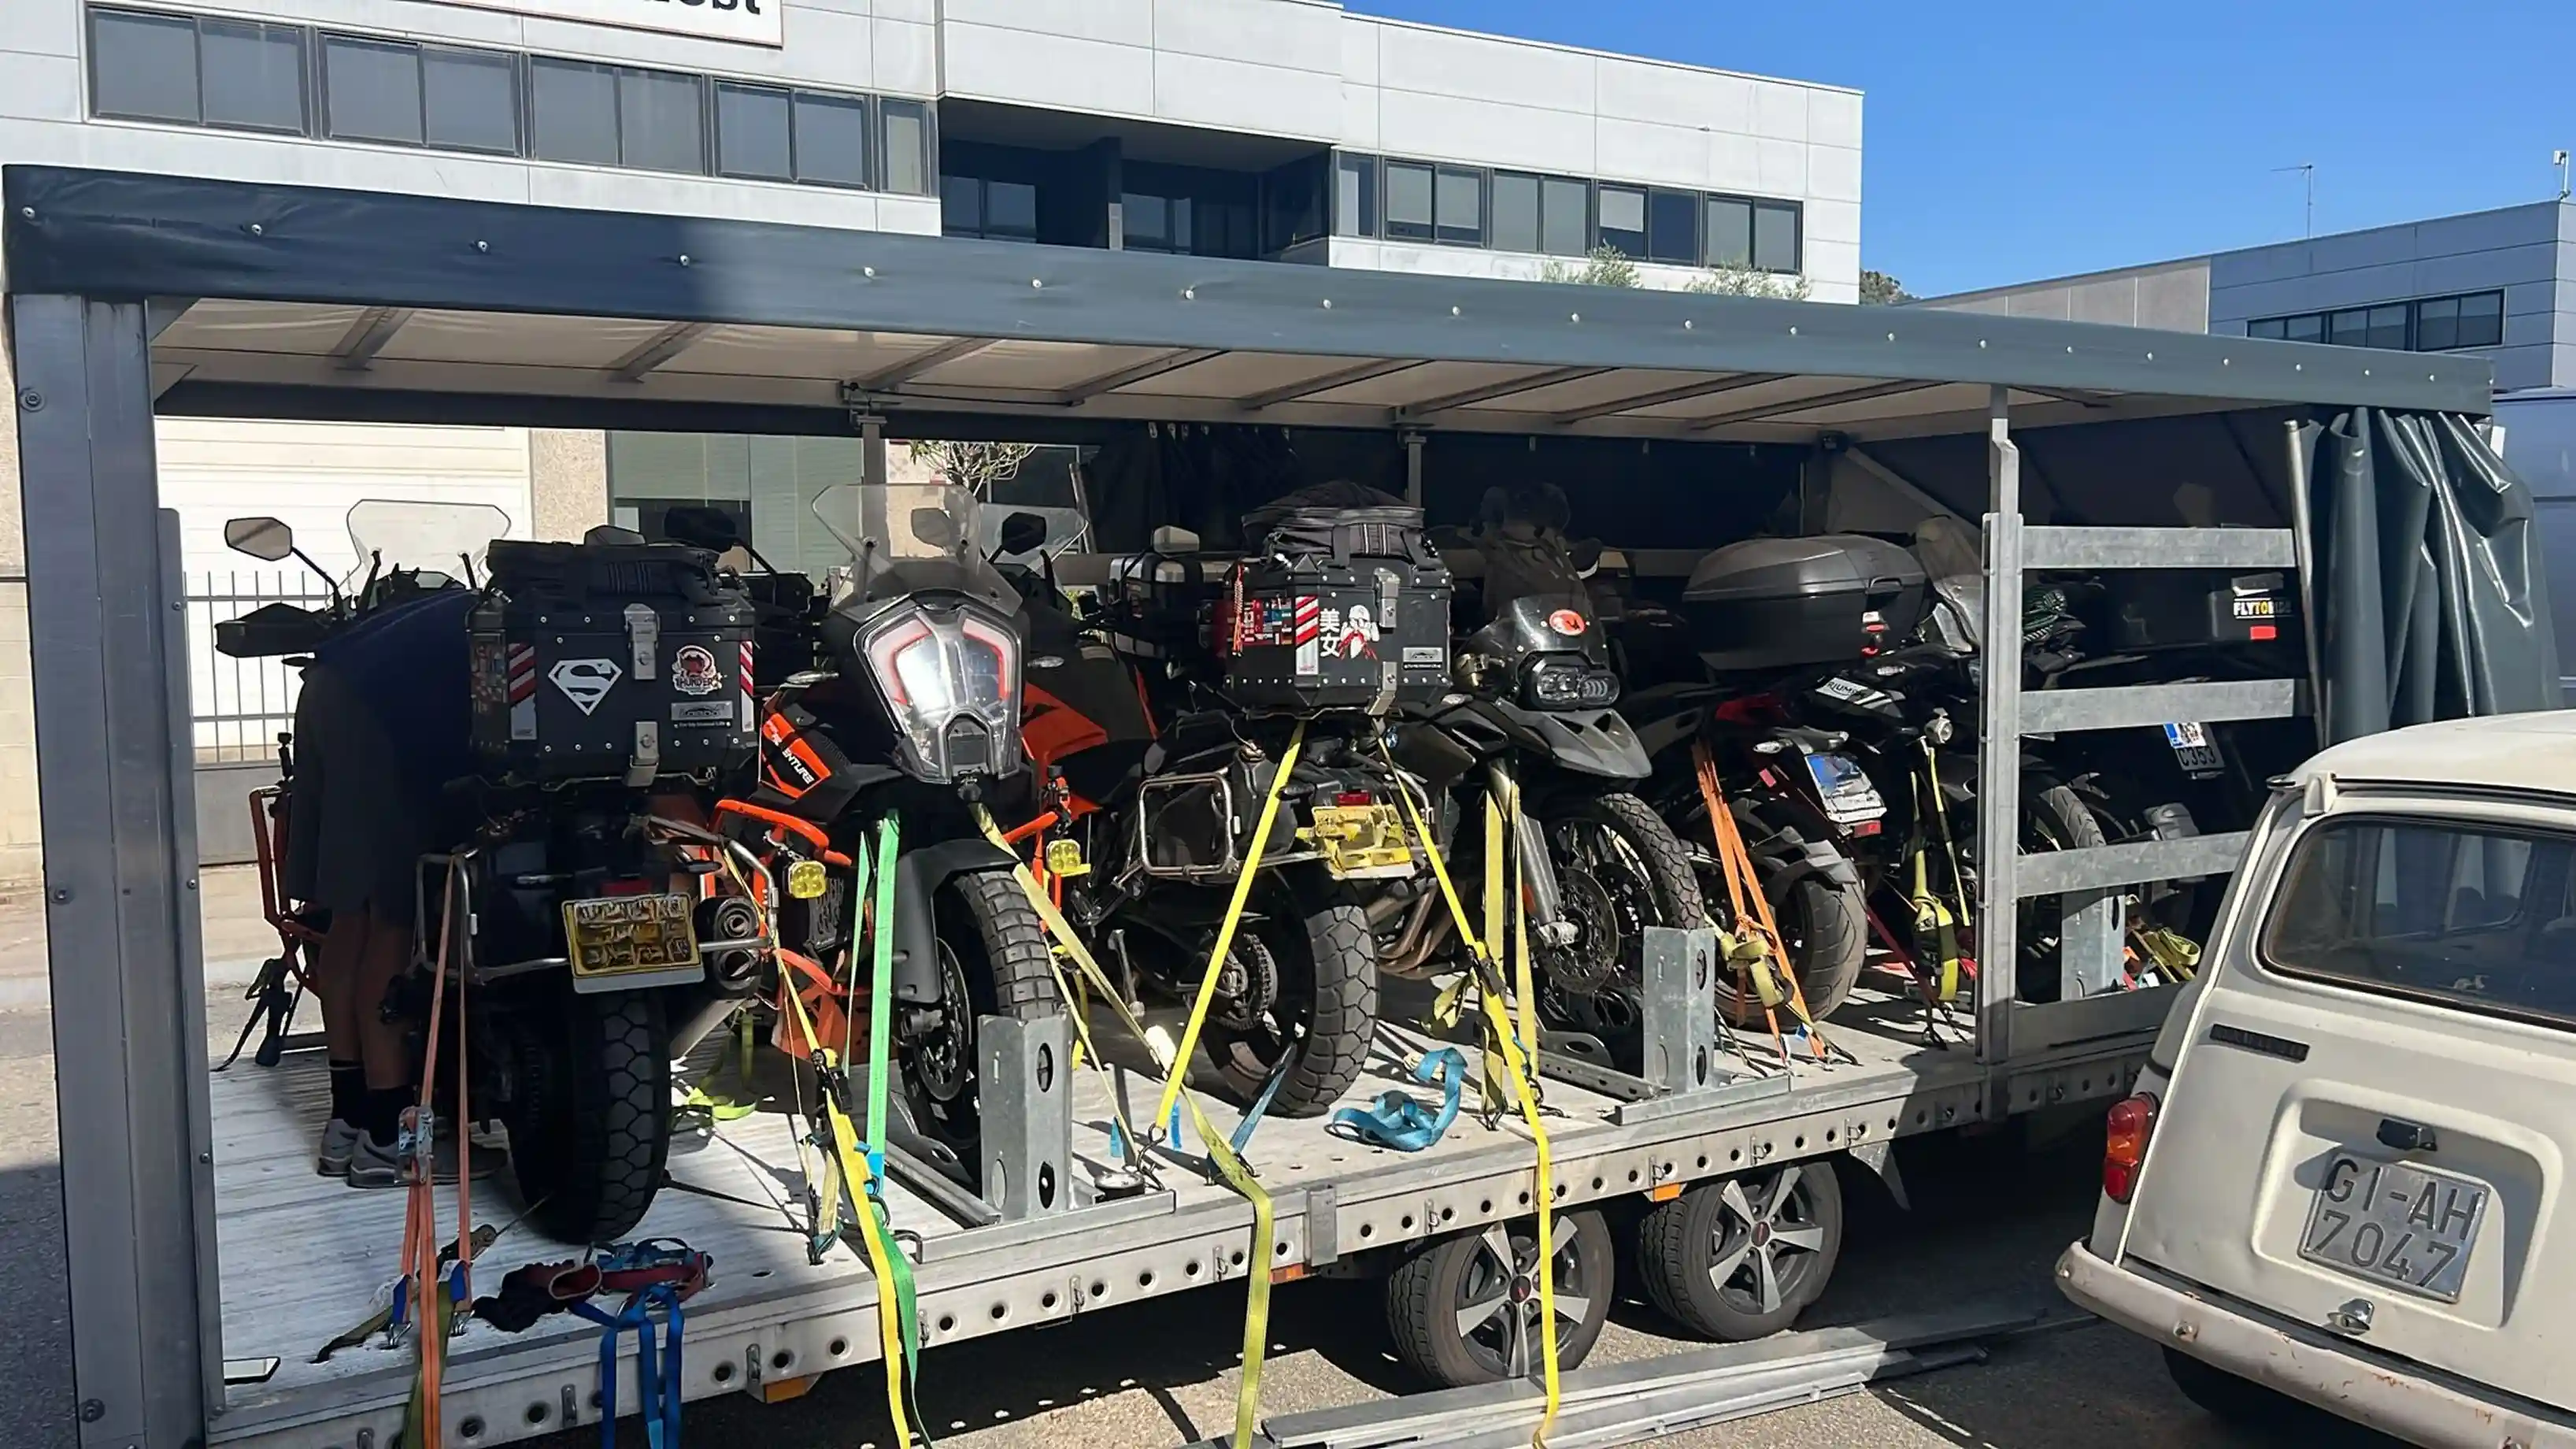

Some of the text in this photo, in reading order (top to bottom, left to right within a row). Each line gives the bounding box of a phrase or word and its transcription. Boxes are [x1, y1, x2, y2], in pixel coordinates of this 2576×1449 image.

[1319, 608, 1341, 657] 美女
[2324, 1158, 2485, 1241] GI-AH
[2313, 1209, 2459, 1288] 7047
